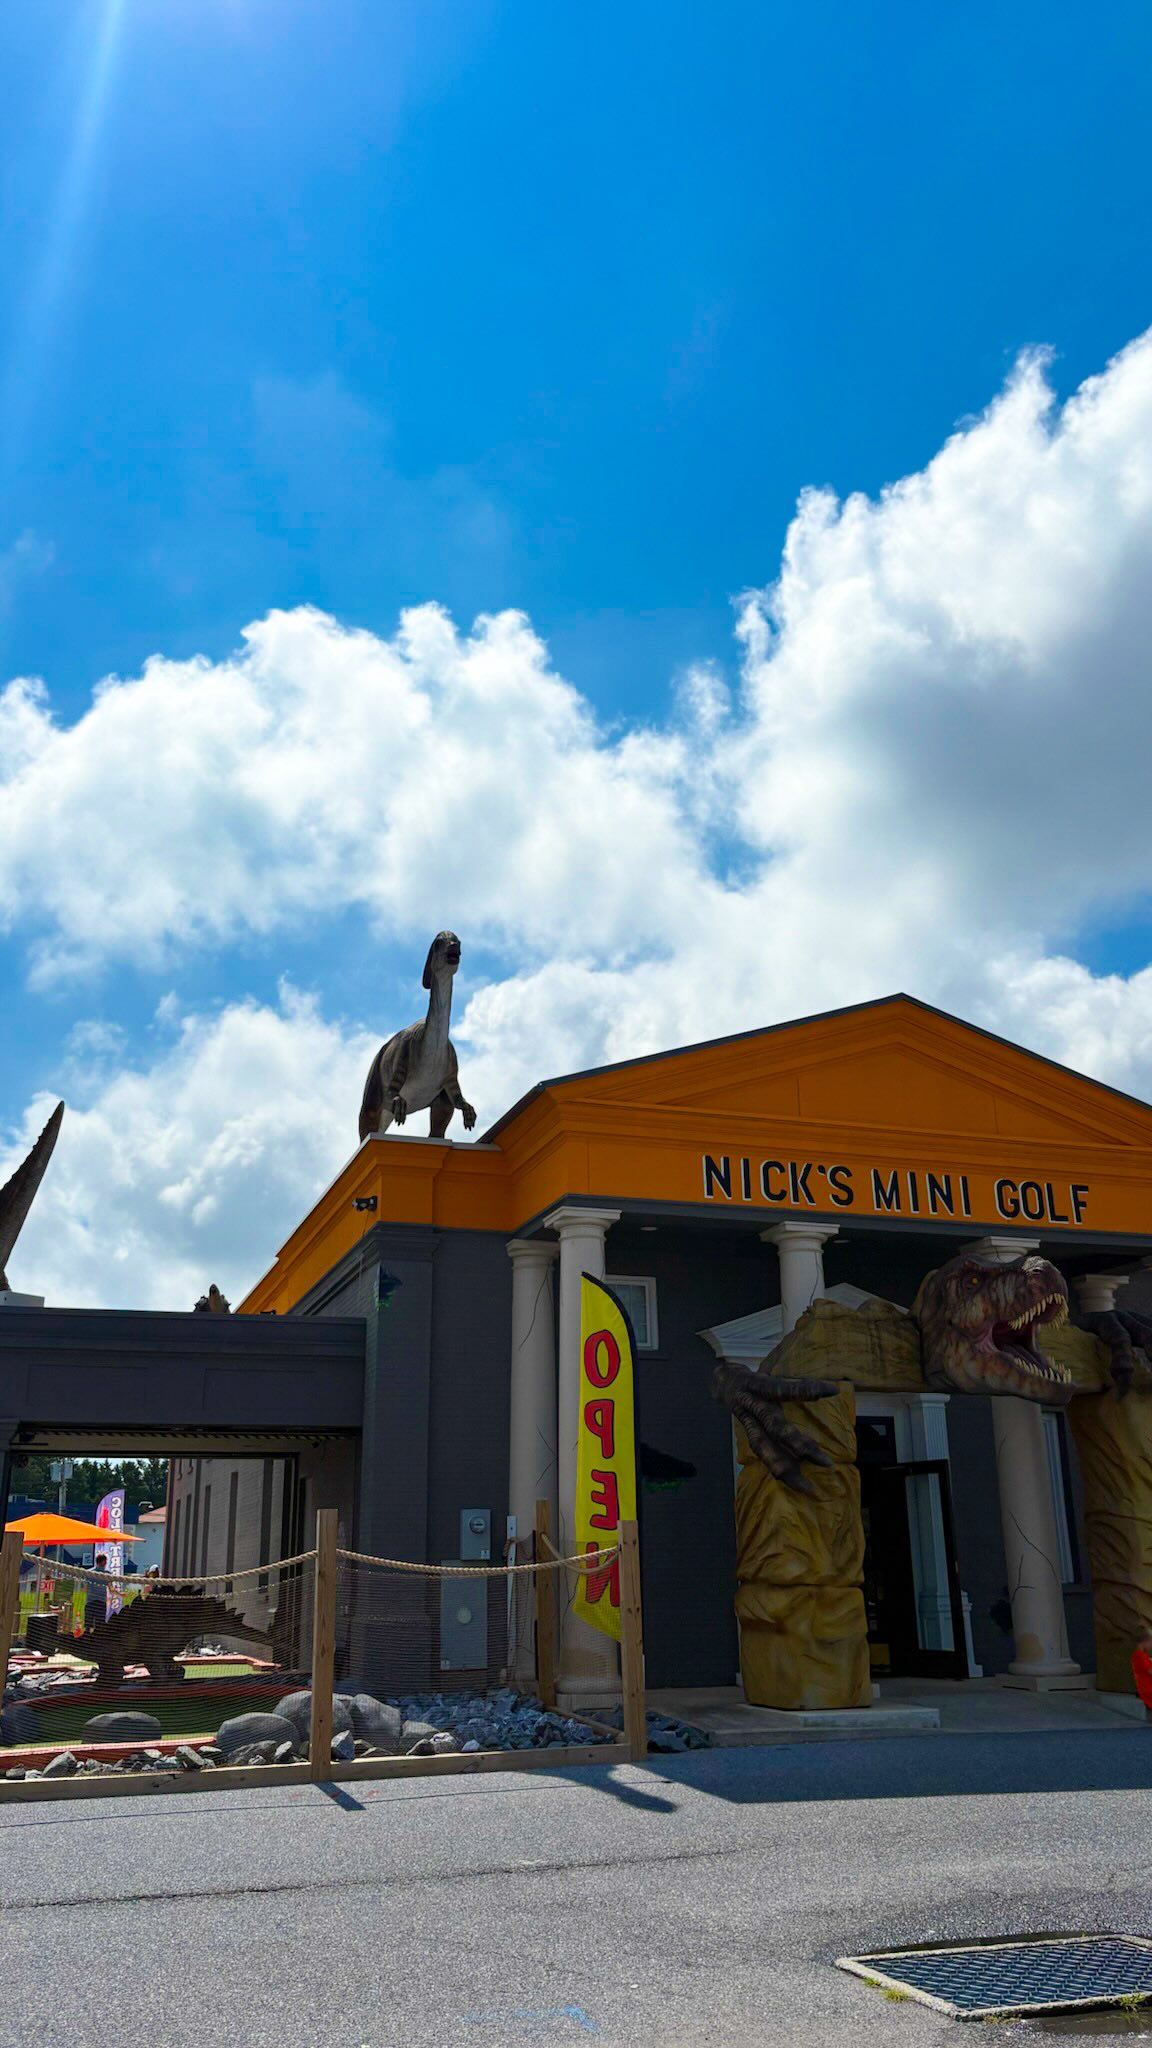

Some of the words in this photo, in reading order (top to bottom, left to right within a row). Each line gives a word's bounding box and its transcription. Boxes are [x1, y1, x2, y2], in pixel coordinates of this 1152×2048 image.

[702, 1155, 854, 1207] NICK'S
[871, 1168, 972, 1217] MINI
[994, 1178, 1089, 1225] GOLF
